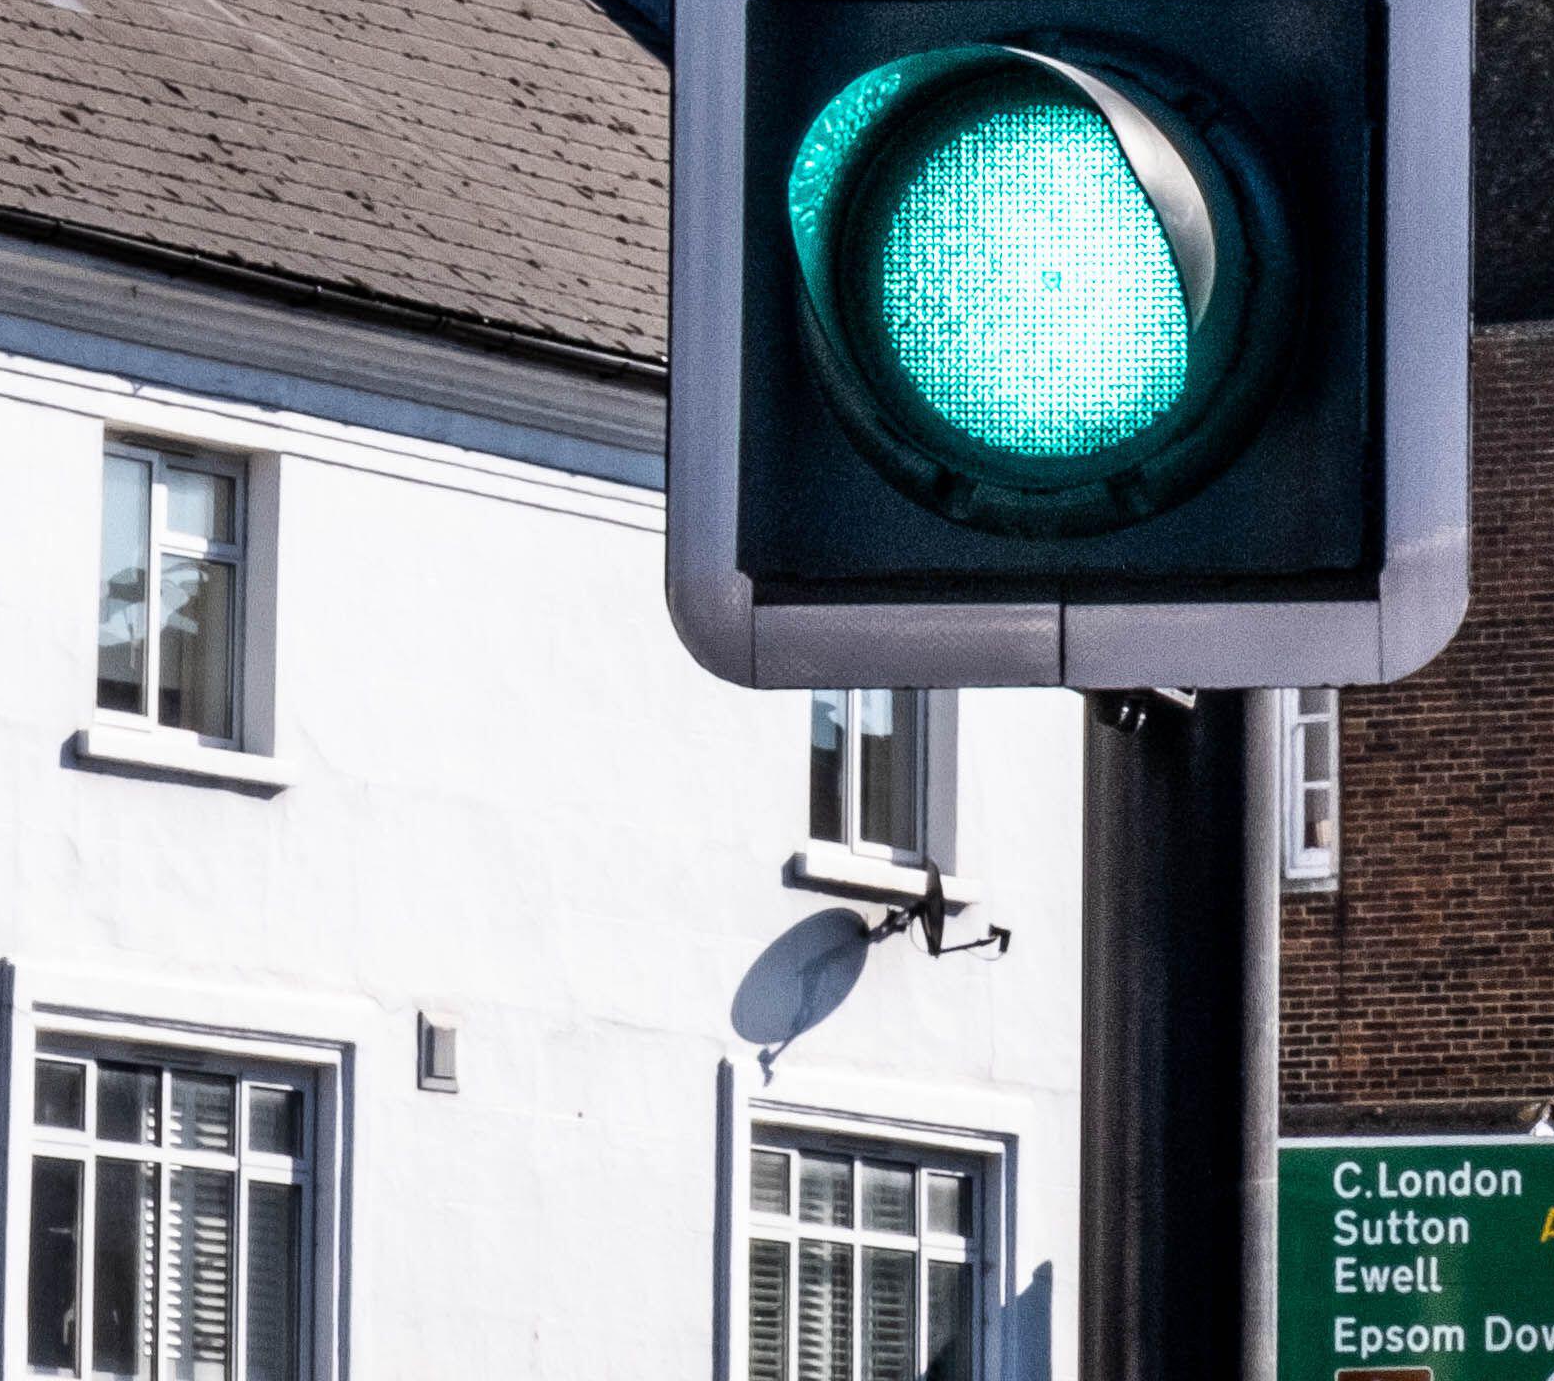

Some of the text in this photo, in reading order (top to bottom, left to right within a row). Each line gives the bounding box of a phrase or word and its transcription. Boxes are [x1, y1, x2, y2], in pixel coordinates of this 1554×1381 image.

[1333, 1160, 1522, 1199] C.London
[1333, 1209, 1469, 1246] Sutton
[1334, 1256, 1442, 1294] Ewell
[1334, 1316, 1465, 1360] Epsom
